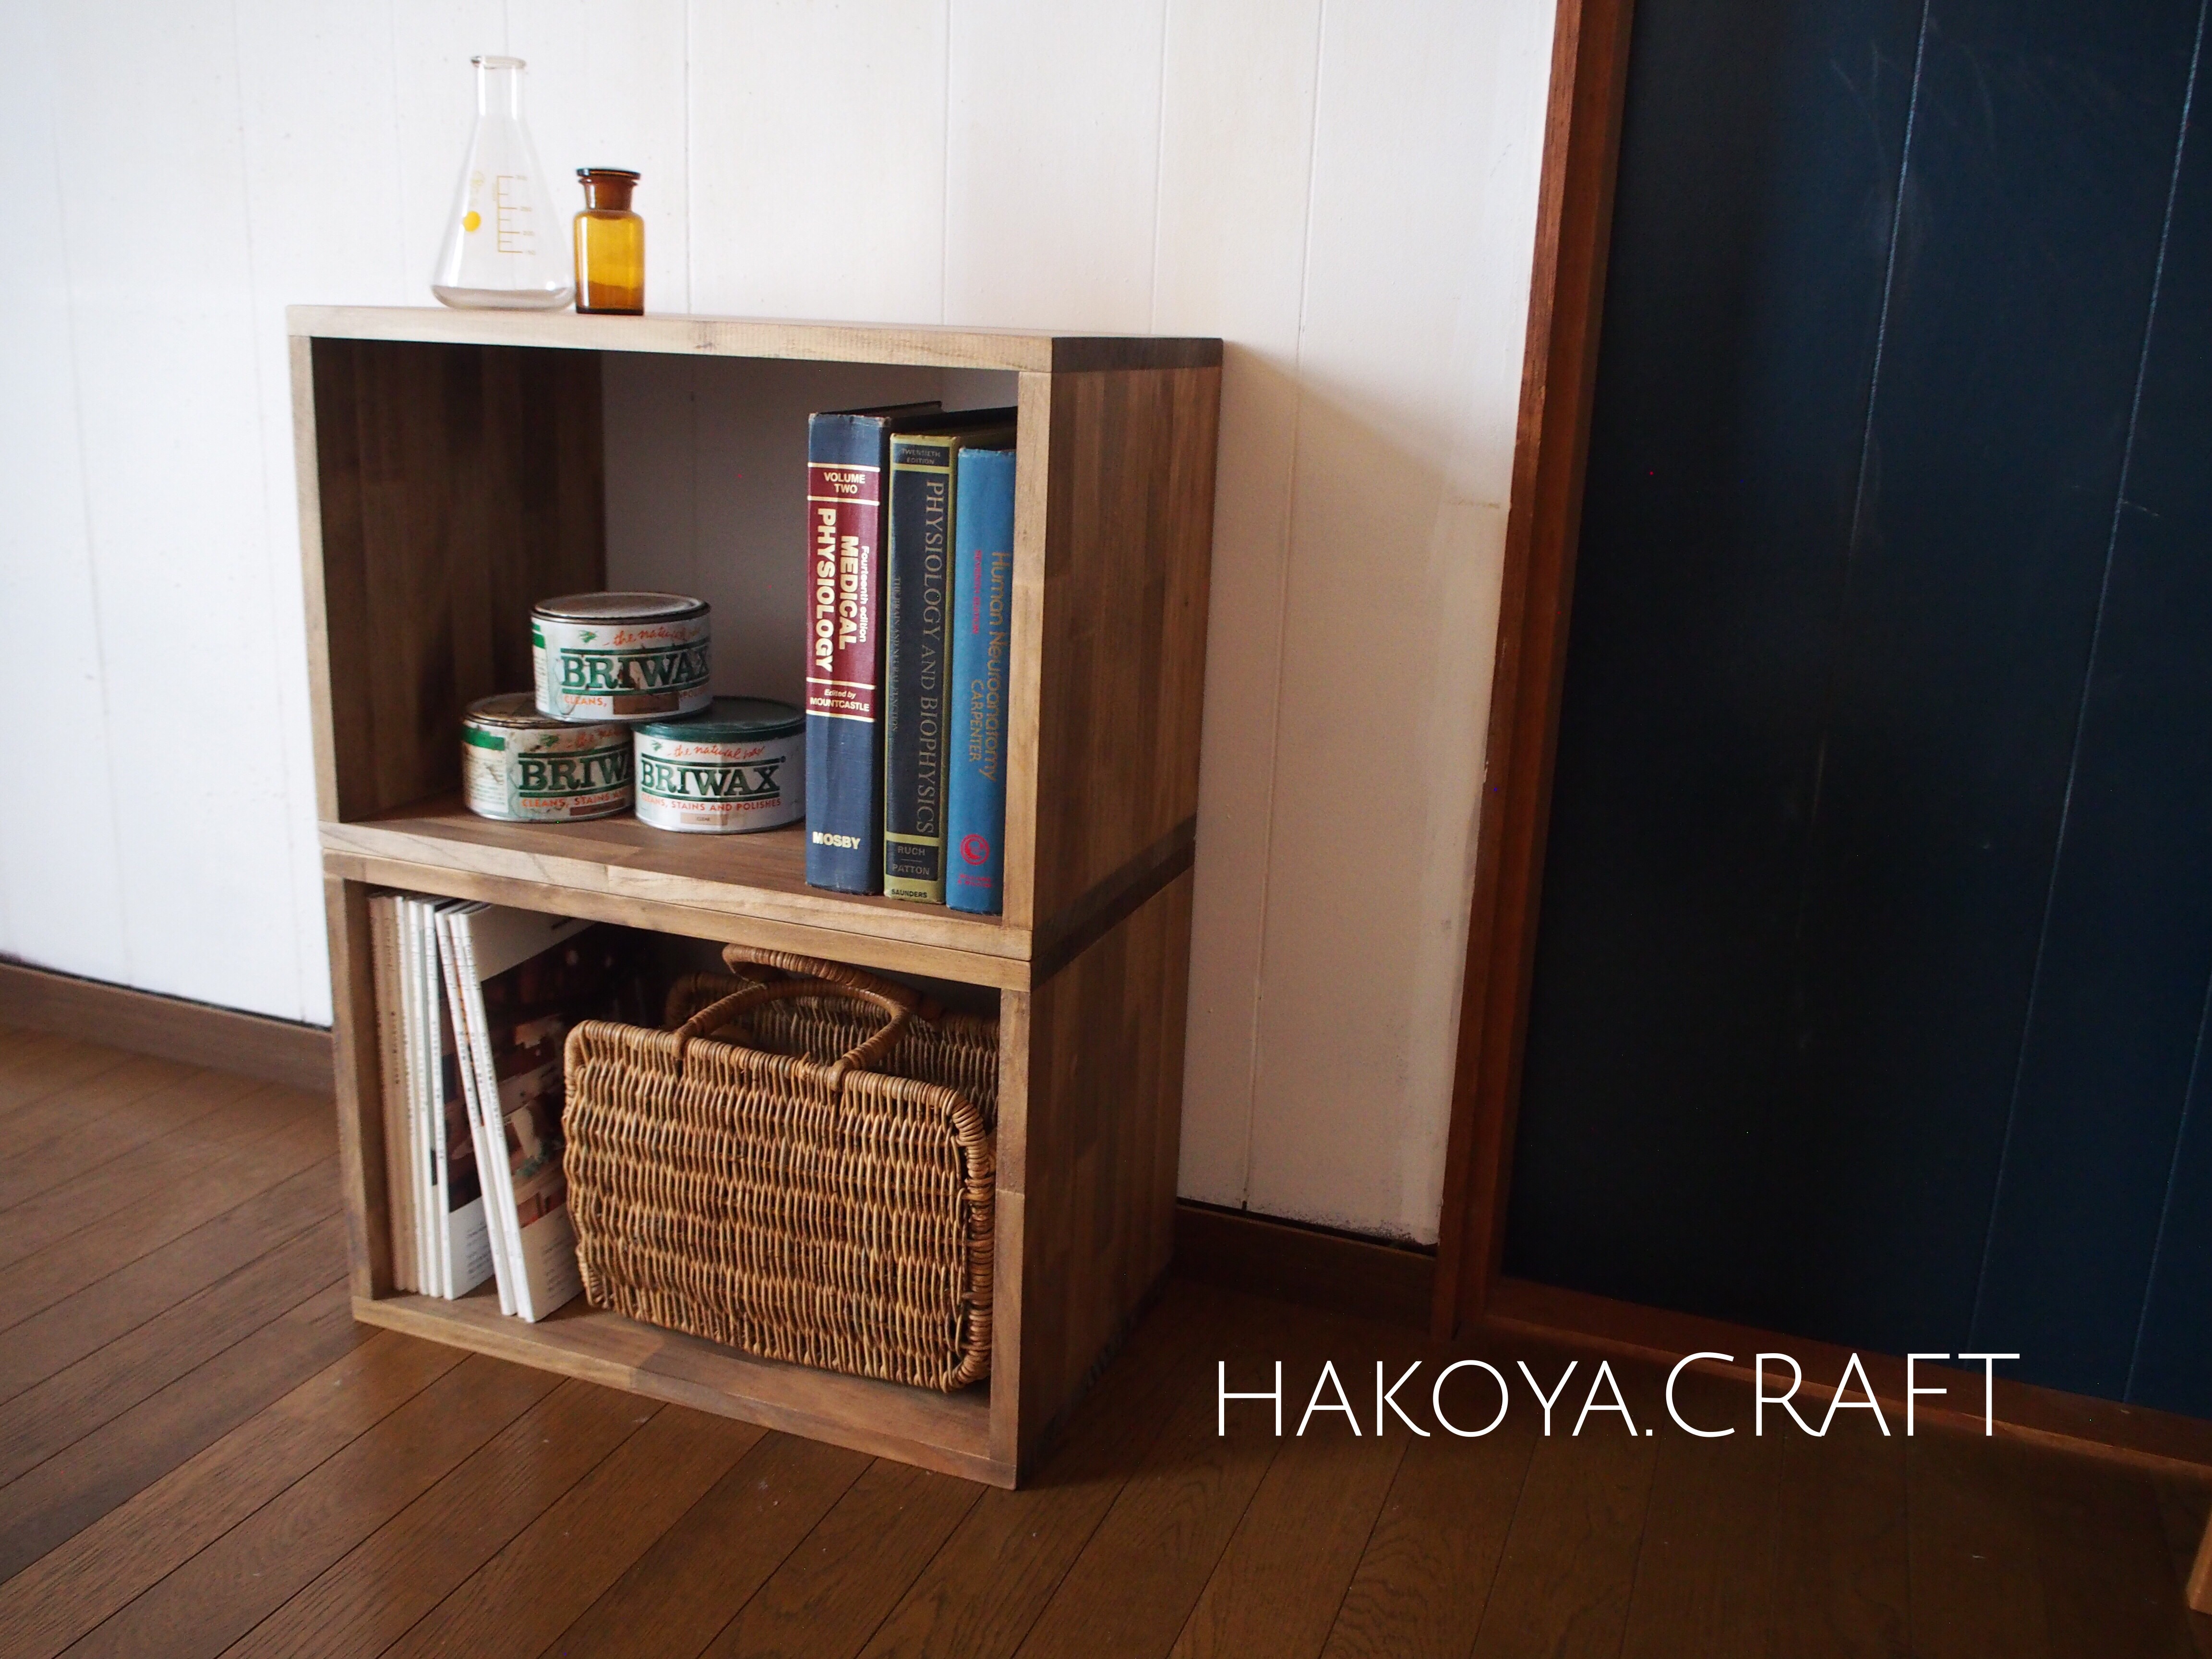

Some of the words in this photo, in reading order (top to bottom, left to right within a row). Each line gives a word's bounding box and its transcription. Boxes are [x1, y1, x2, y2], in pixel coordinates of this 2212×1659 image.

[824, 472, 866, 484] VOLUME
[834, 483, 858, 494] TWO
[860, 545, 870, 604] Fourteenth
[923, 481, 944, 641] PHYSIOLOGY
[816, 508, 836, 673] PHYSIOLOGY
[839, 535, 859, 650] MEDICAL
[989, 551, 1010, 625] Human
[613, 630, 637, 647] the
[859, 605, 869, 643] edition
[560, 645, 710, 689] BRIWAX
[920, 645, 936, 690] AND
[809, 697, 870, 712] MOUNTCASTLE
[824, 688, 847, 698] Edited
[847, 691, 856, 700] by
[979, 630, 1008, 782] Neuroanatomy
[968, 679, 984, 763] CARPENTER
[518, 748, 631, 791] BRIW
[673, 744, 692, 757] the
[693, 745, 741, 759] natural
[915, 697, 938, 833] BIOPHYSICS
[641, 760, 781, 796] BRIWAX
[522, 798, 569, 808] CLEANS,
[574, 792, 610, 805] STAINS
[672, 801, 705, 811] STAINS
[709, 802, 733, 812] AND
[736, 797, 782, 812] POLISHES
[812, 831, 861, 850] MOSBY
[897, 845, 926, 856] RUCH
[892, 863, 930, 876] PATTON
[891, 888, 928, 899] SAUNDERS
